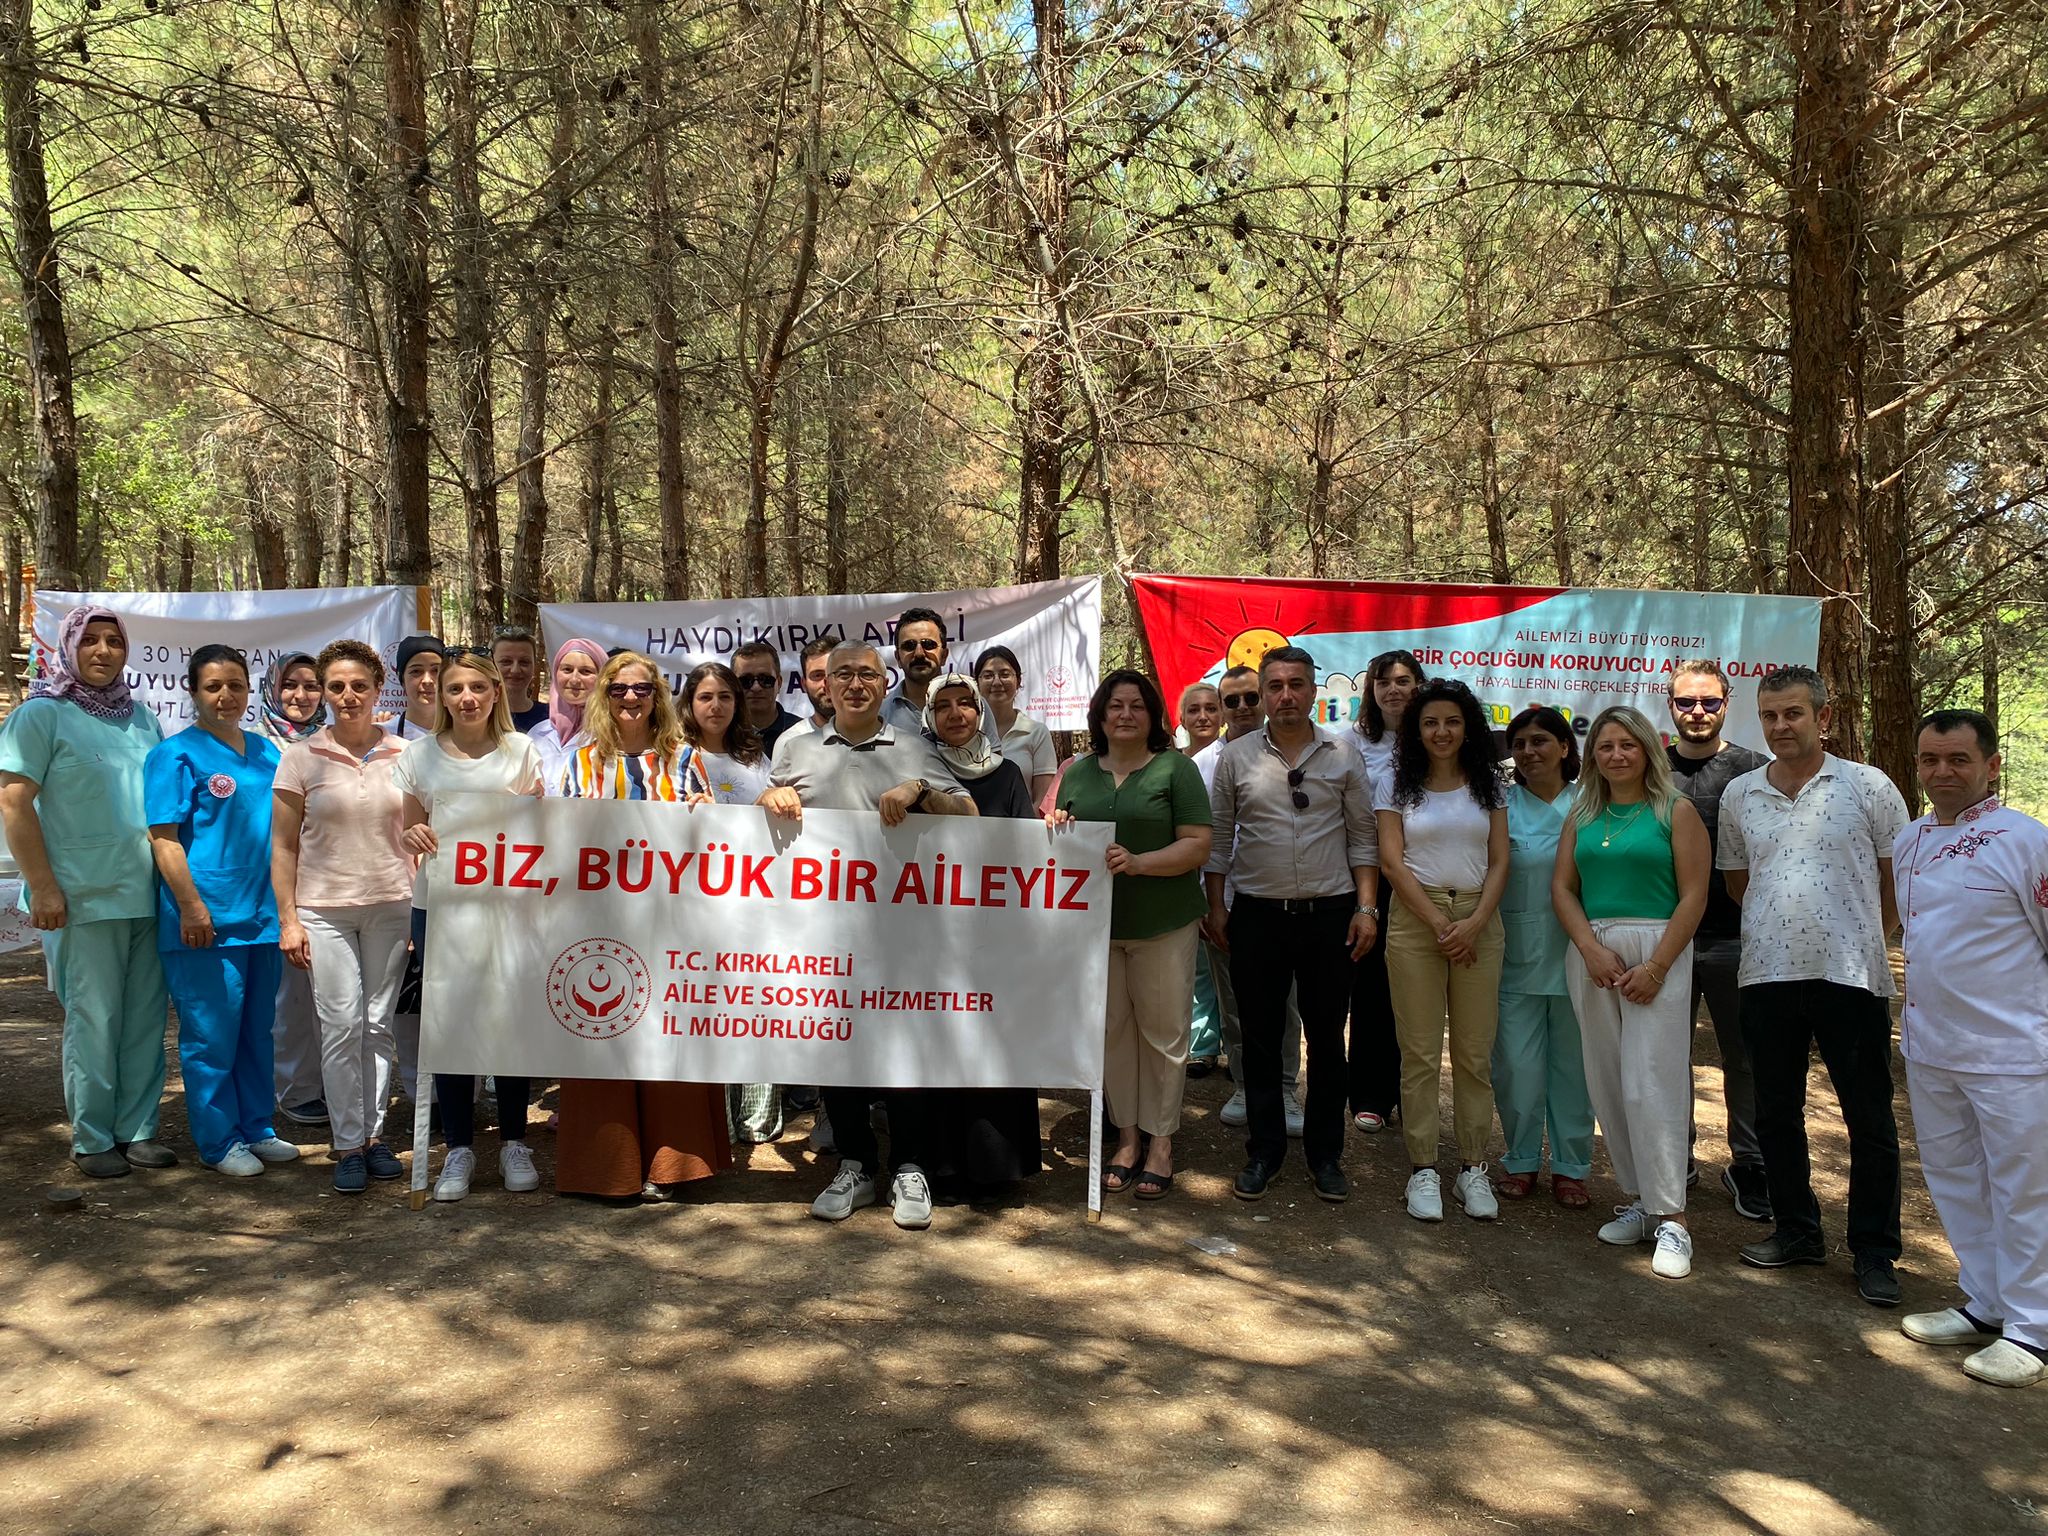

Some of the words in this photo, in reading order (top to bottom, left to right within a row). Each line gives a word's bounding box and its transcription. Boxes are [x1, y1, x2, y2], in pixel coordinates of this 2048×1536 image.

[646, 619, 742, 654] HAYDİ
[1515, 629, 1582, 643] AİLEMİZİ
[1589, 632, 1705, 648] BÜYÜTÜYORUZ!
[143, 645, 170, 662] 30
[1412, 646, 1444, 665] BİR
[1450, 649, 1545, 669] ÇOCUĞUN
[1550, 654, 1655, 672] KORUYUCU
[1476, 676, 1560, 690] HAYALLERİNİ
[455, 833, 560, 896] BİZ,
[578, 839, 776, 899] BÜYÜK
[790, 848, 878, 903] BİR
[892, 853, 1090, 910] AİLEYİZ
[665, 951, 708, 970] T.C.
[715, 952, 853, 976] KIRKLARELİ
[664, 980, 718, 1005] AİLE
[724, 984, 755, 1006] VE
[761, 986, 853, 1008] SOSYAL
[860, 986, 994, 1012] HİZMETLER
[662, 1011, 682, 1035] İL
[690, 1013, 852, 1041] MÜDÜRLÜĞÜ
